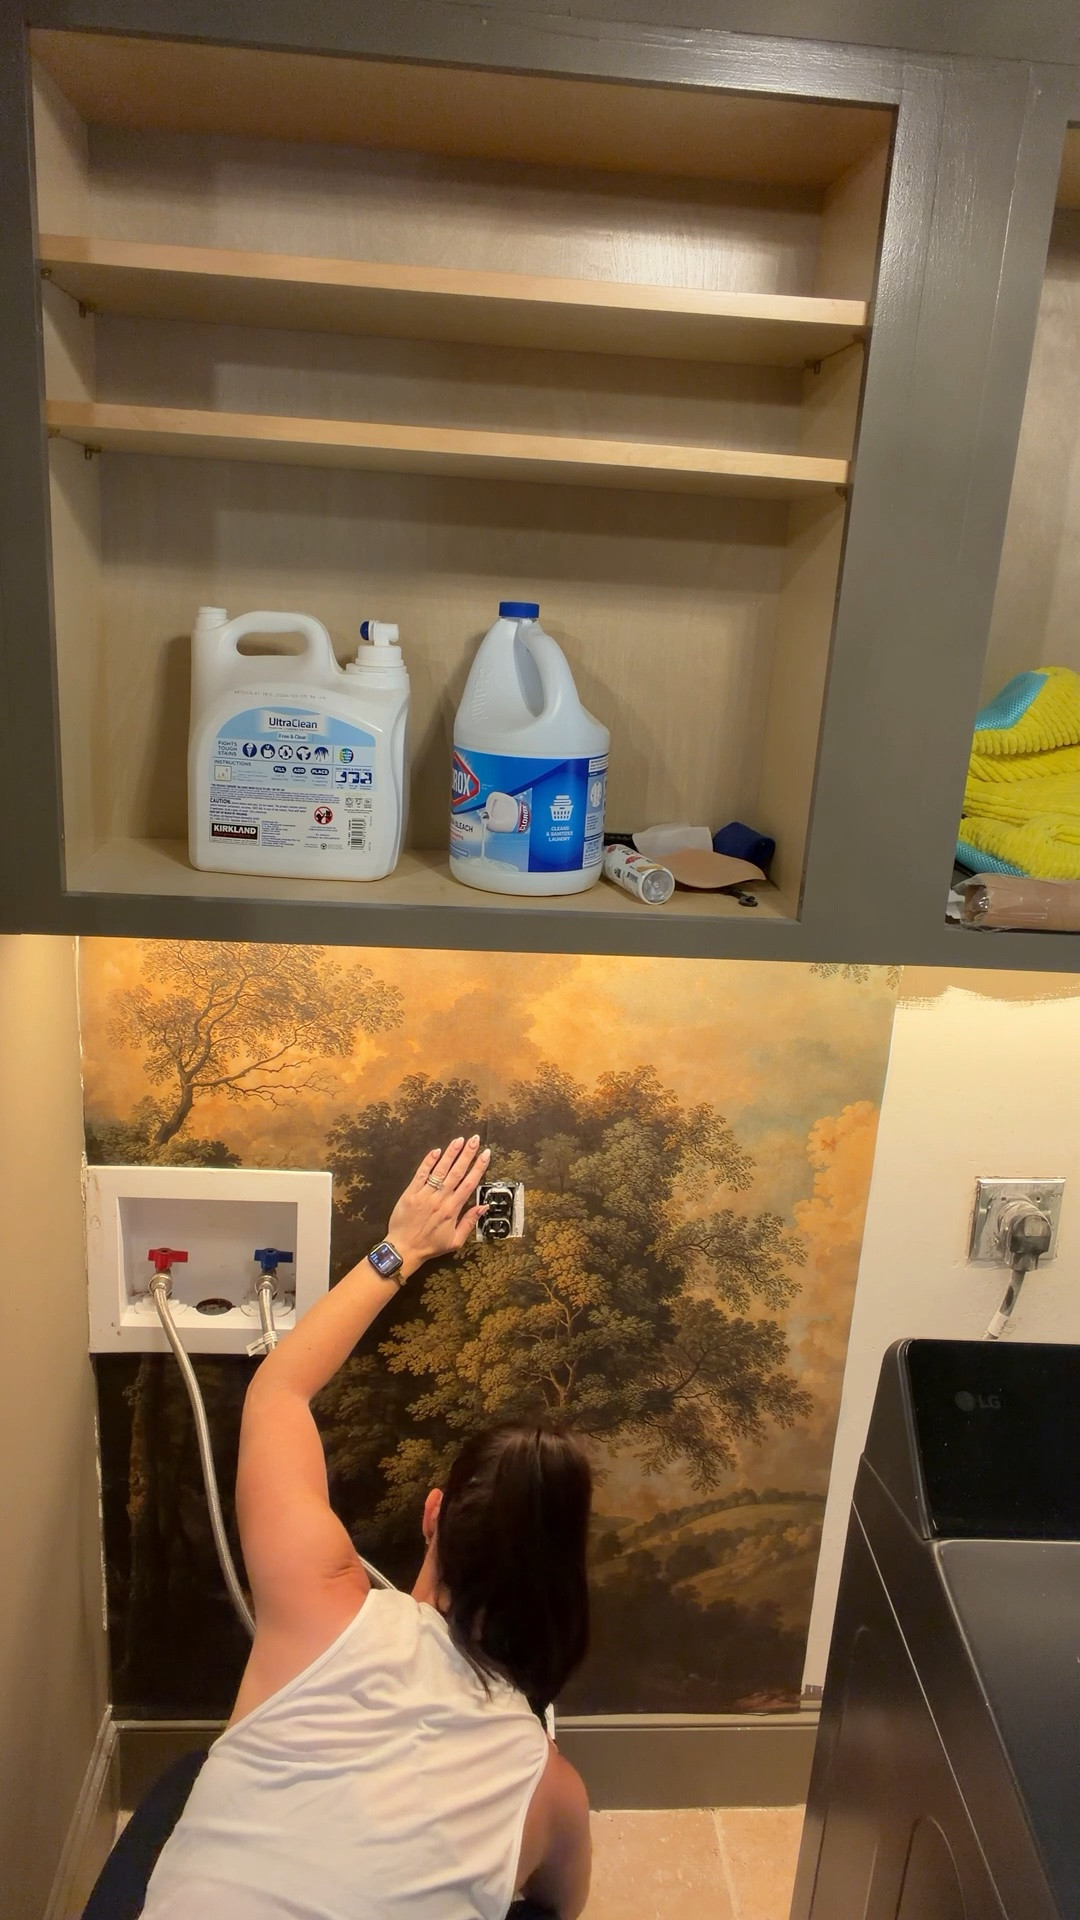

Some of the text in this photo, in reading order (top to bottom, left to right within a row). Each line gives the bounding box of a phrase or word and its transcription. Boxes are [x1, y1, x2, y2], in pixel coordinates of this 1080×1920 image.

[268, 717, 317, 729] UltraClean
[214, 759, 252, 767] INSTRUCTIONS
[518, 805, 529, 831] CLOROX
[213, 824, 257, 835] KIRKLAND
[978, 1394, 1001, 1409] LG
